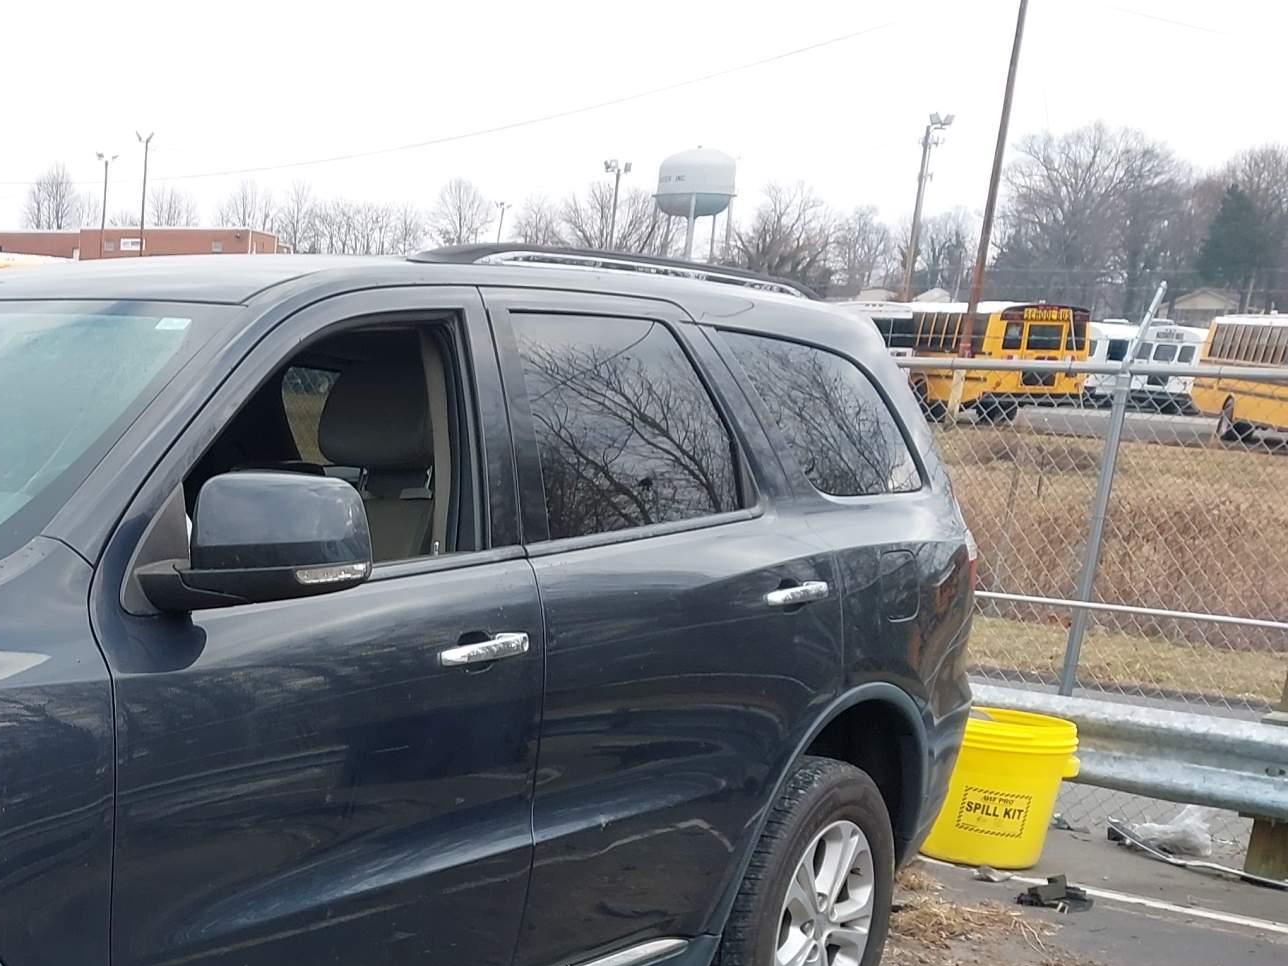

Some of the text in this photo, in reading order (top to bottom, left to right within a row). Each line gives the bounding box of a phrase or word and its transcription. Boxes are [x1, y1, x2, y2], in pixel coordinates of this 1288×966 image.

[1025, 308, 1072, 321] SCHOOL BUS
[965, 801, 1025, 821] SPILL KIT
